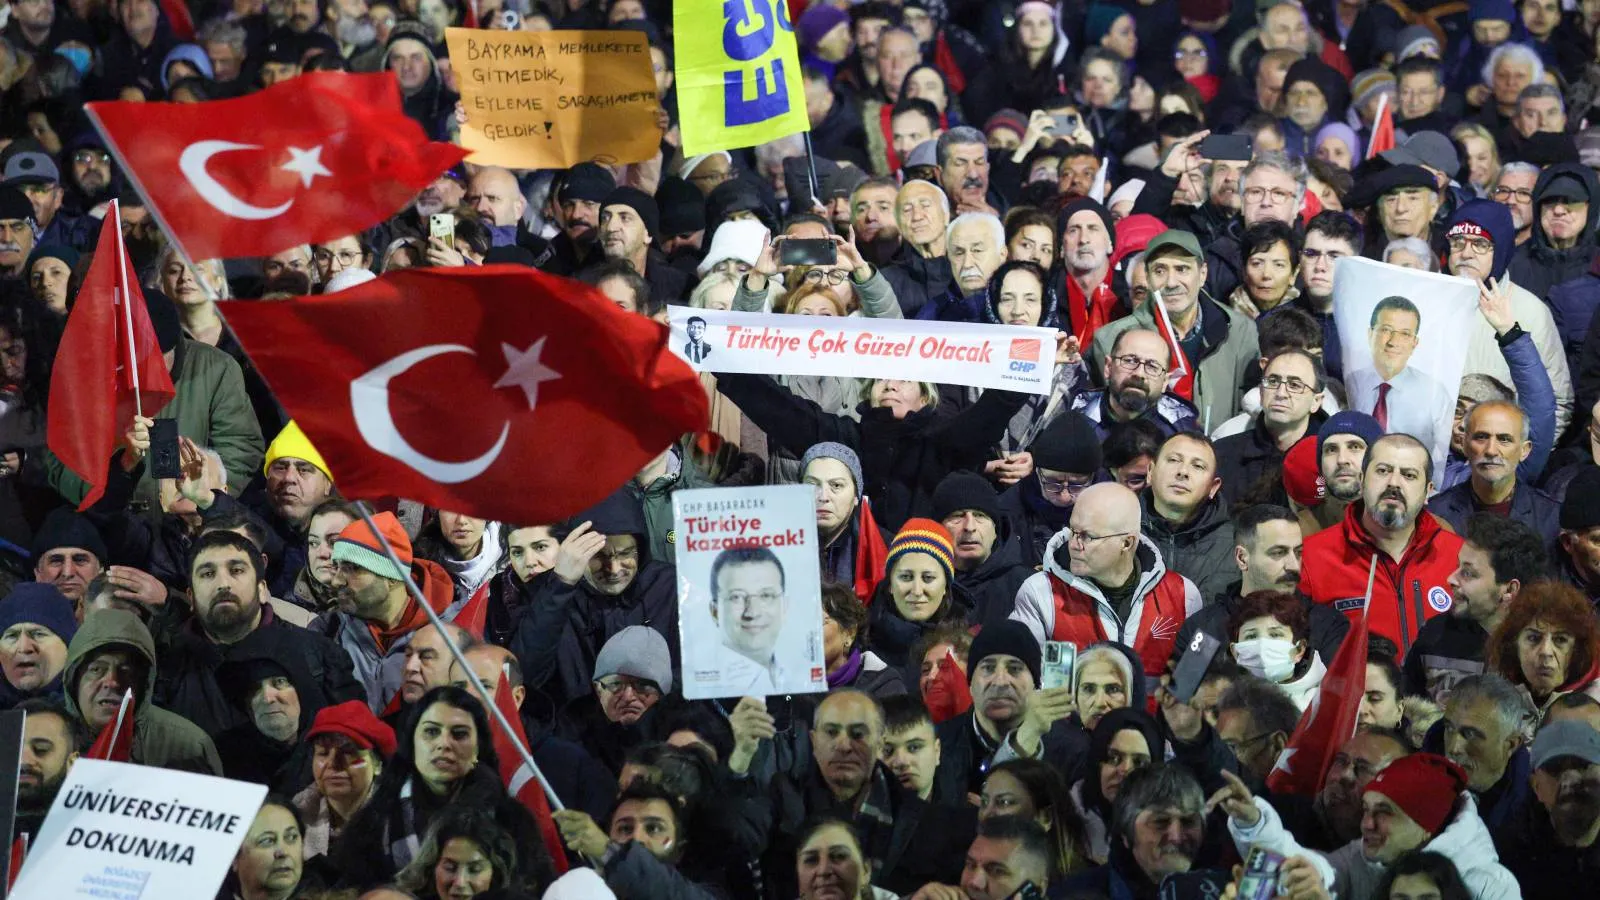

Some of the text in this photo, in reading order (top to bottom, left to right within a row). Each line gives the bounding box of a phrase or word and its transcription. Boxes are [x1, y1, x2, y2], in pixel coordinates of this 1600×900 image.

[467, 38, 642, 61] BAYRAMA MEMLEKETE
[472, 66, 565, 85] GİTMEDİK,
[475, 95, 544, 111] EYLEME
[726, 325, 993, 363] Türkiye Çok Güzel Olacak
[1009, 361, 1037, 373] CHP
[683, 498, 766, 513] CHP BAŞARACAK
[684, 514, 762, 535] Türkiye
[686, 528, 805, 552] kazanacak!
[63, 784, 240, 835] ÜNİVERSİTEME
[66, 827, 196, 866] DOKUNMA
